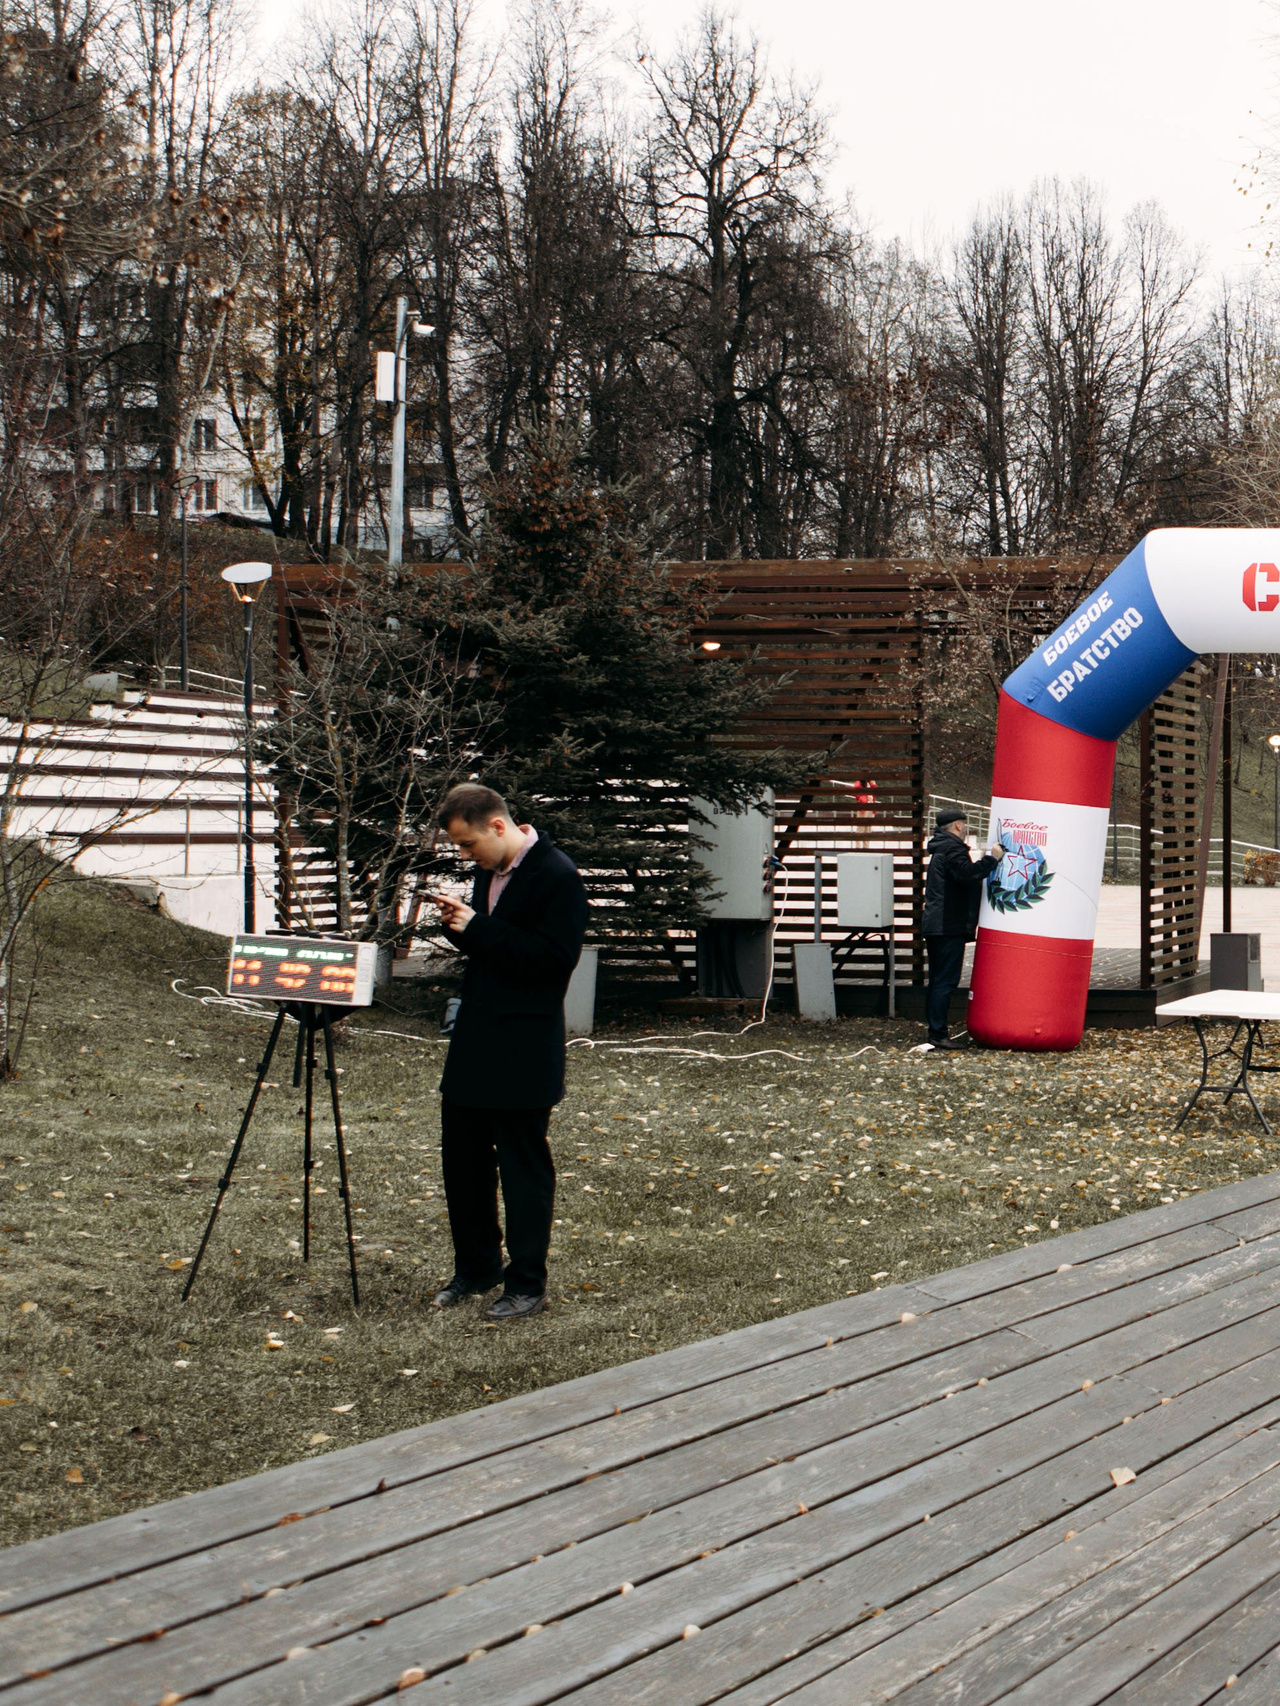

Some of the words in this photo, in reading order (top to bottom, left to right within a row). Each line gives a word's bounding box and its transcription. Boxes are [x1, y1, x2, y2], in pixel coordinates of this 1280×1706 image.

[1042, 591, 1114, 667] БОЕВОЕ
[1046, 606, 1143, 703] БРАТСТВО
[1002, 818, 1048, 831] Боевое
